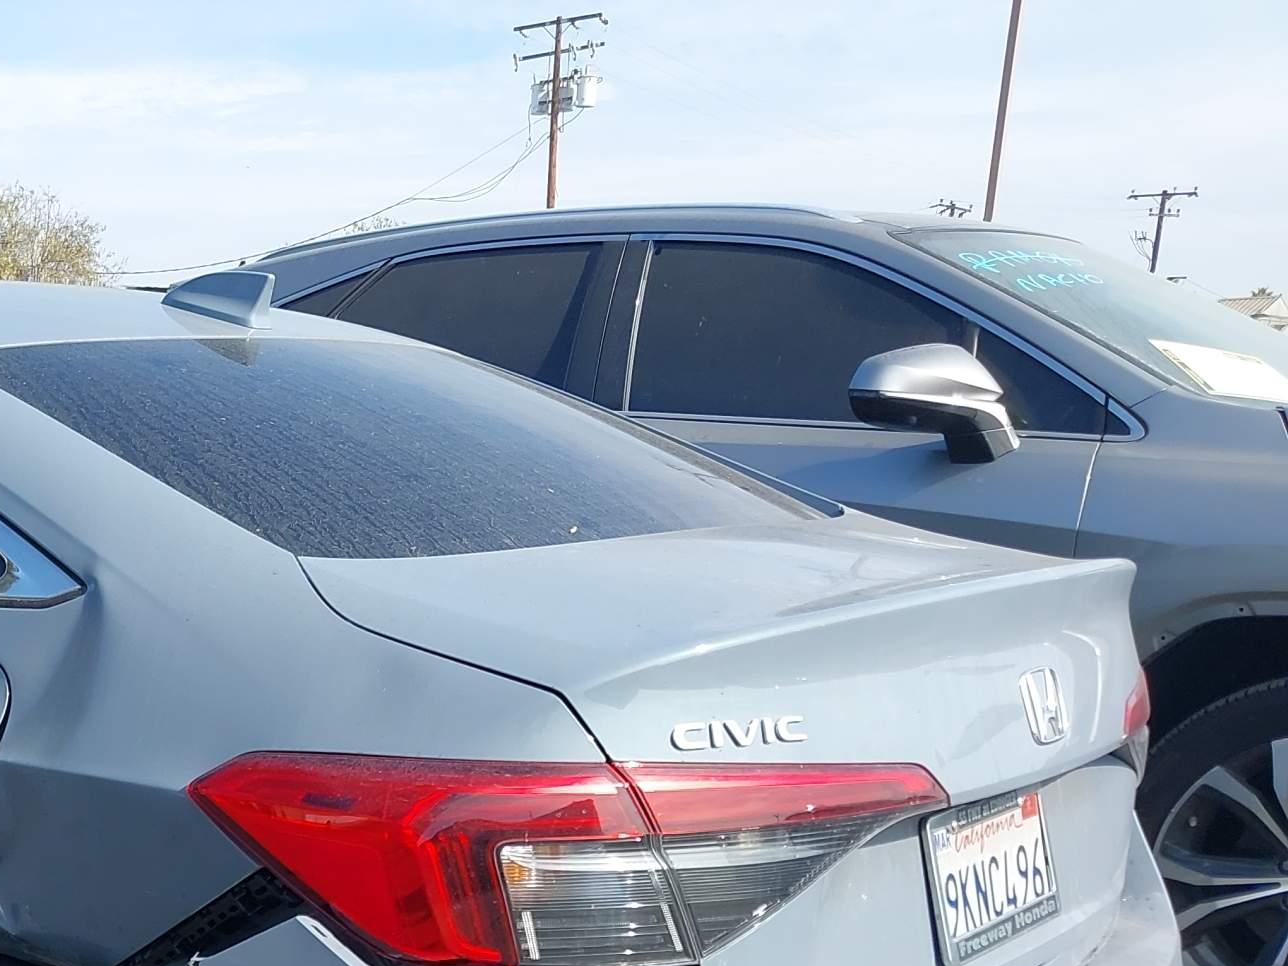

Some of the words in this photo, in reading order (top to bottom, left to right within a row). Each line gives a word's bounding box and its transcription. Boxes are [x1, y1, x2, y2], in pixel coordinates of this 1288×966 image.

[670, 716, 808, 751] CIVIC
[933, 831, 953, 851] MAR
[954, 813, 1023, 853] California
[945, 838, 1045, 938] 9KNC496
[959, 922, 1013, 958] Freeway
[1015, 898, 1057, 929] Honda
